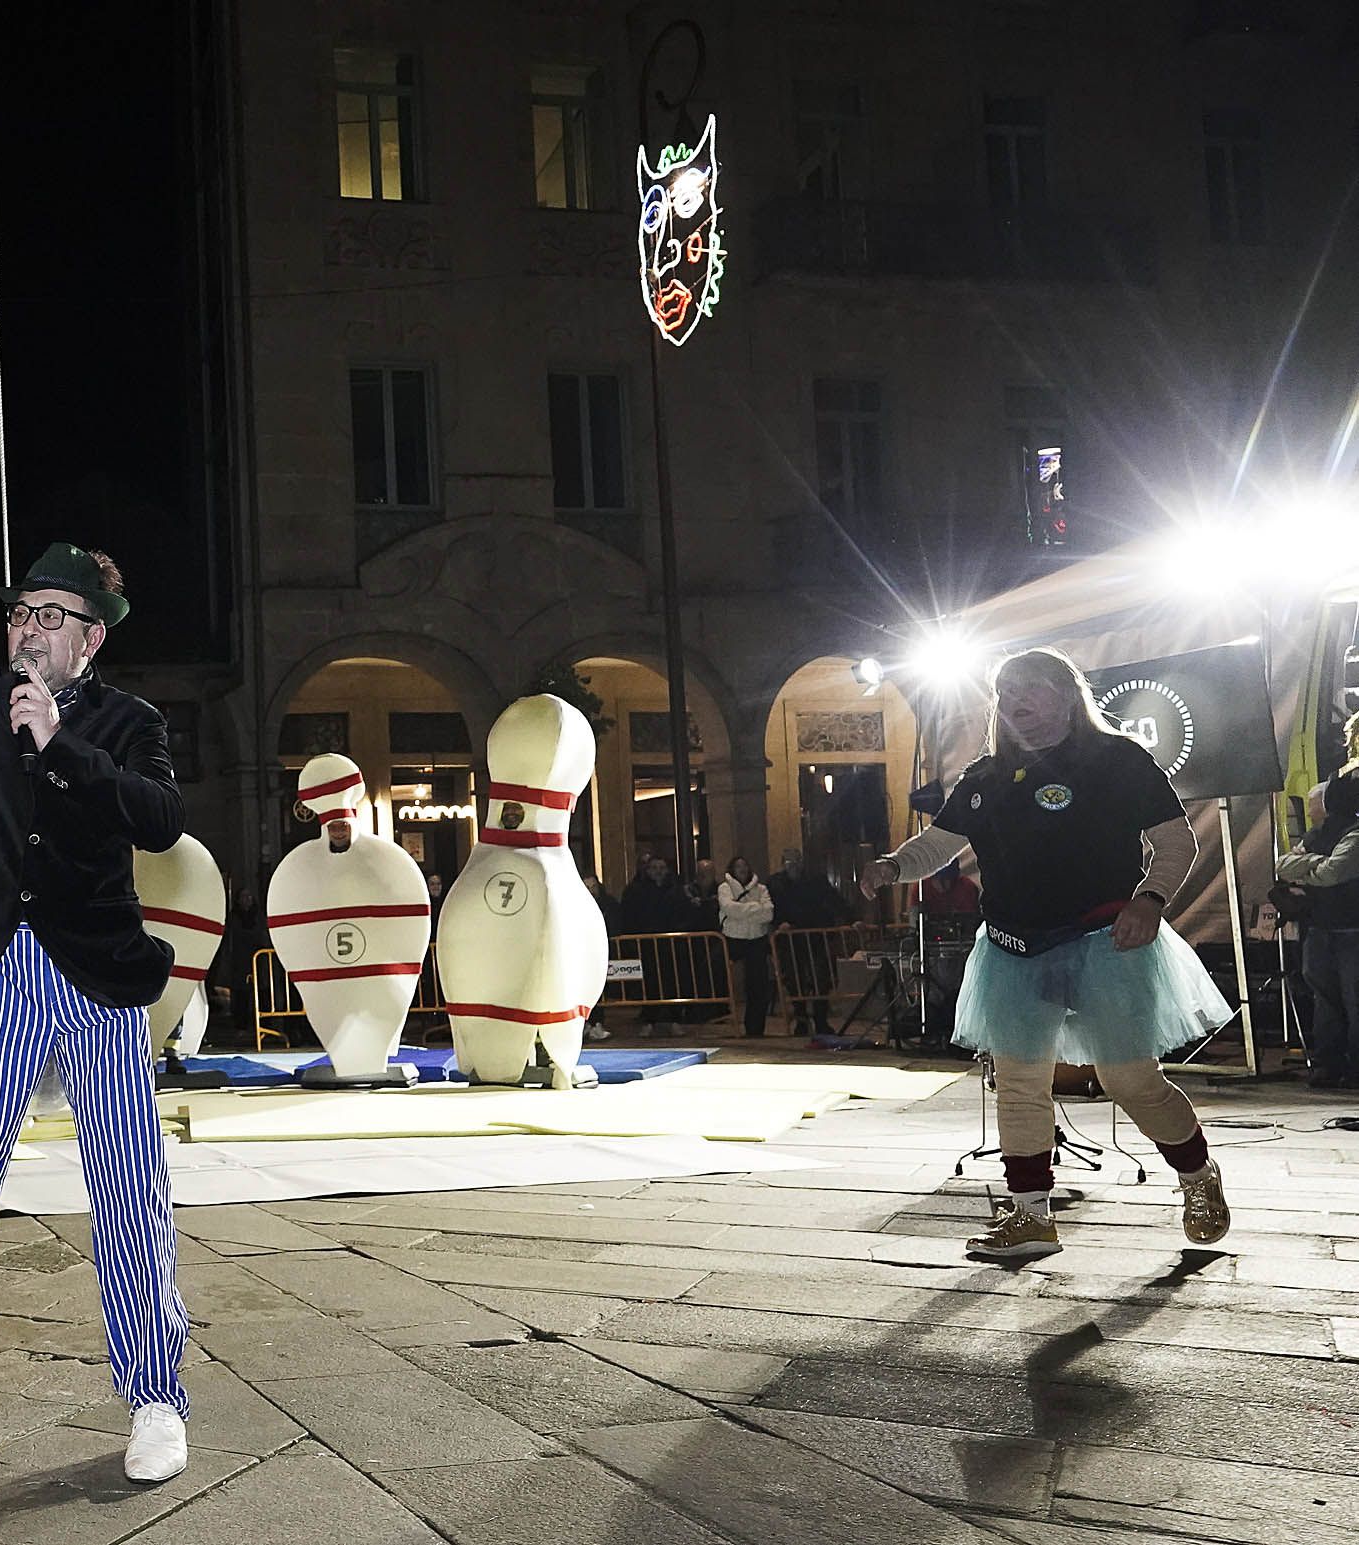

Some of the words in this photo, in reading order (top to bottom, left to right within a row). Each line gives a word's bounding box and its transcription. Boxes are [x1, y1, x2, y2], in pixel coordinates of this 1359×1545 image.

[498, 880, 516, 908] 7
[336, 932, 354, 956] 5
[988, 925, 1026, 952] SPORTS
